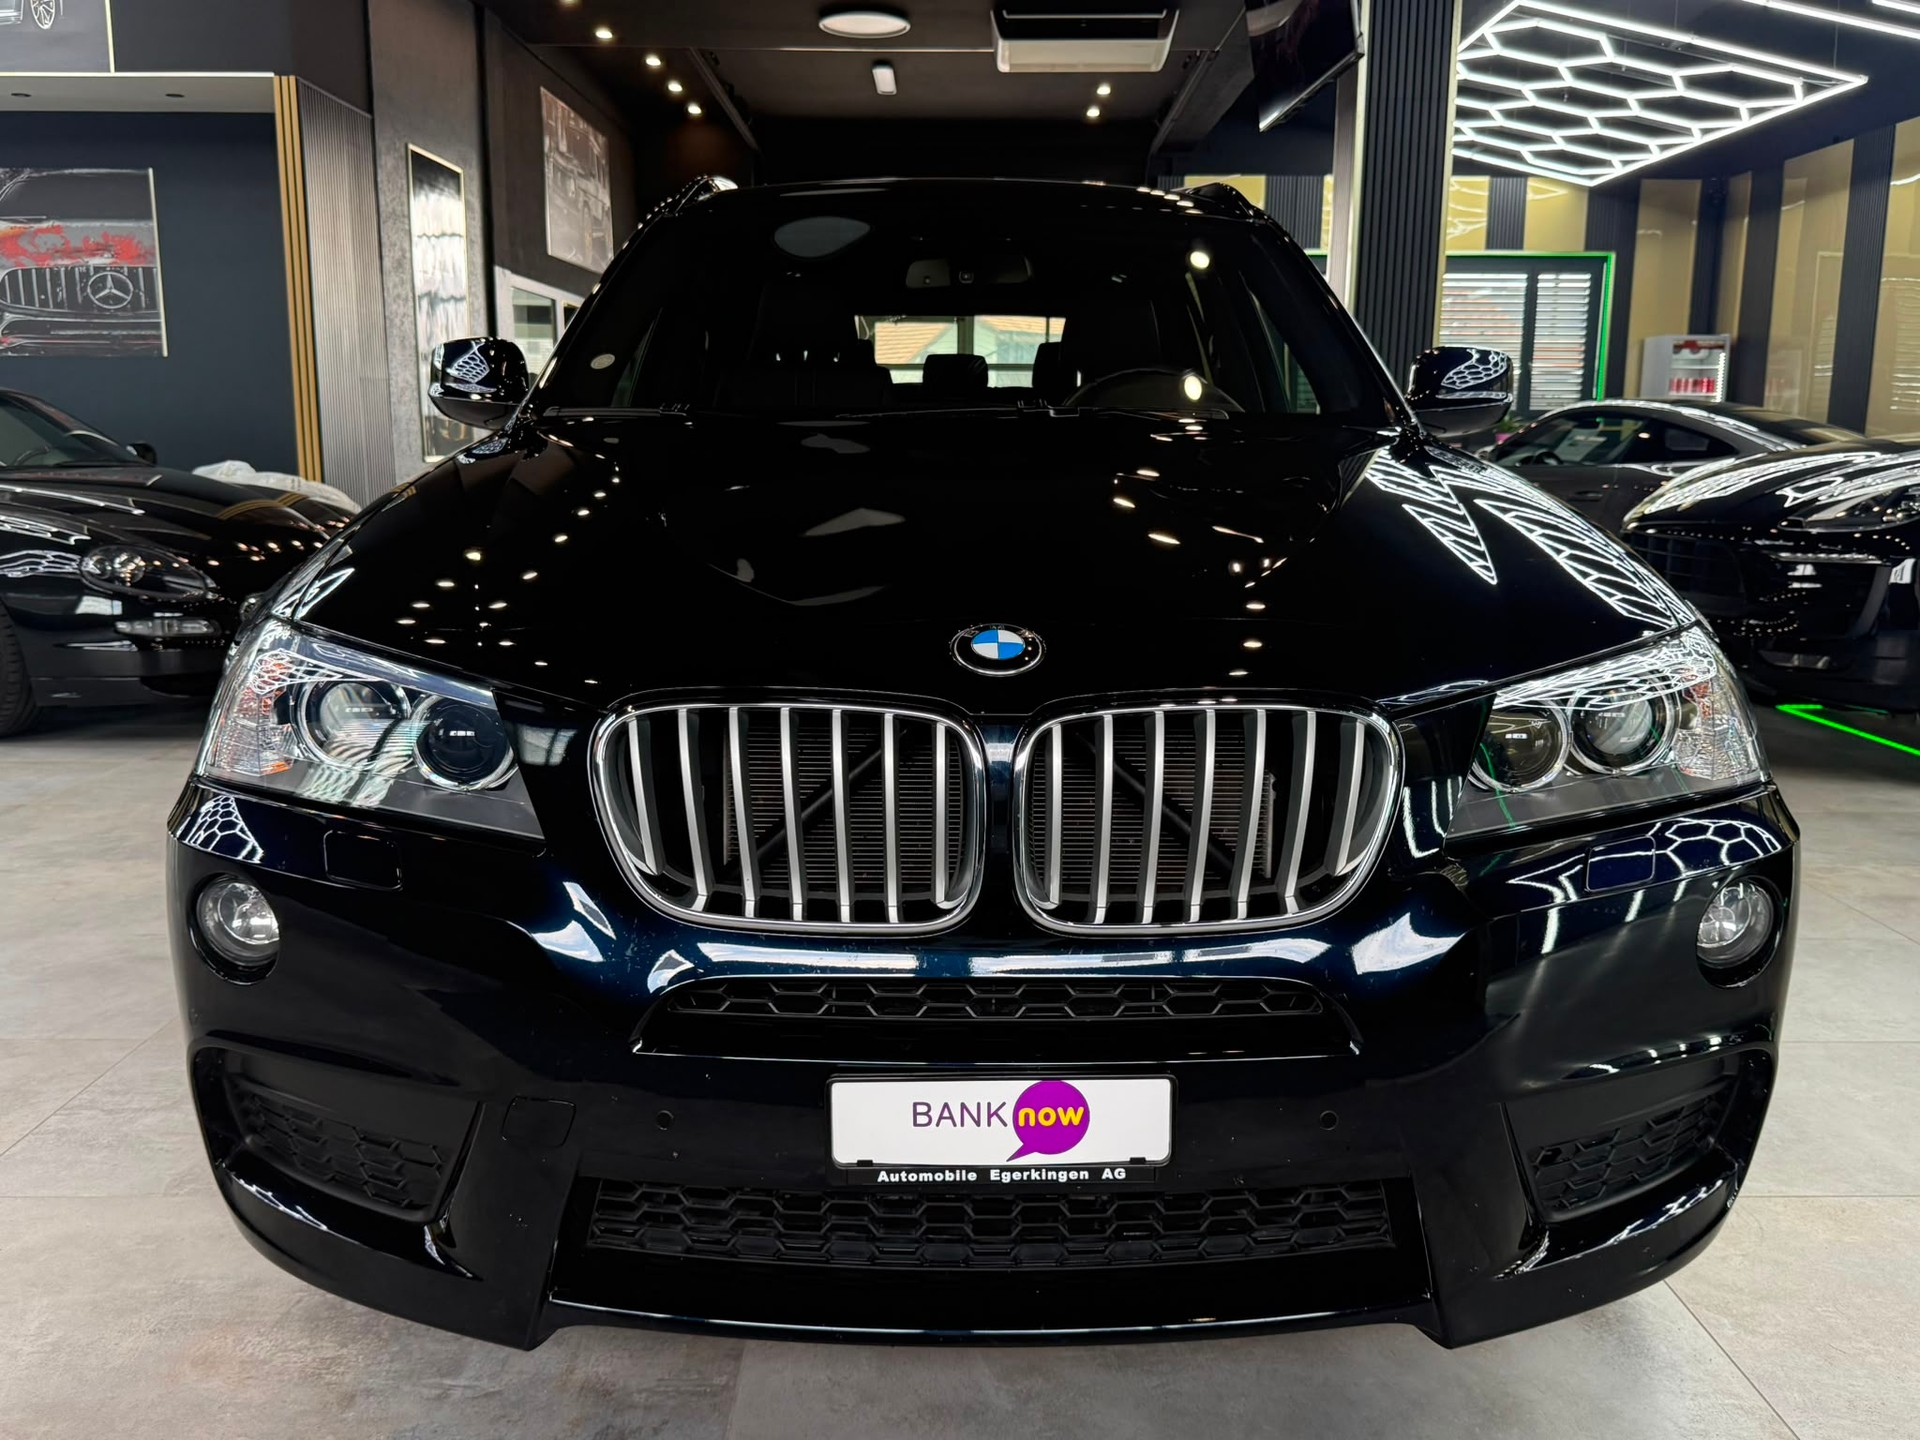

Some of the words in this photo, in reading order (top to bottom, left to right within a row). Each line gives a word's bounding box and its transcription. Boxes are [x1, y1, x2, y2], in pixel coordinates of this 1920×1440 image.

[912, 1101, 1008, 1128] BANK
[1018, 1106, 1085, 1127] now
[877, 1169, 977, 1183] Automobile
[989, 1168, 1090, 1184] Egerkingen
[1101, 1168, 1127, 1180] AG
